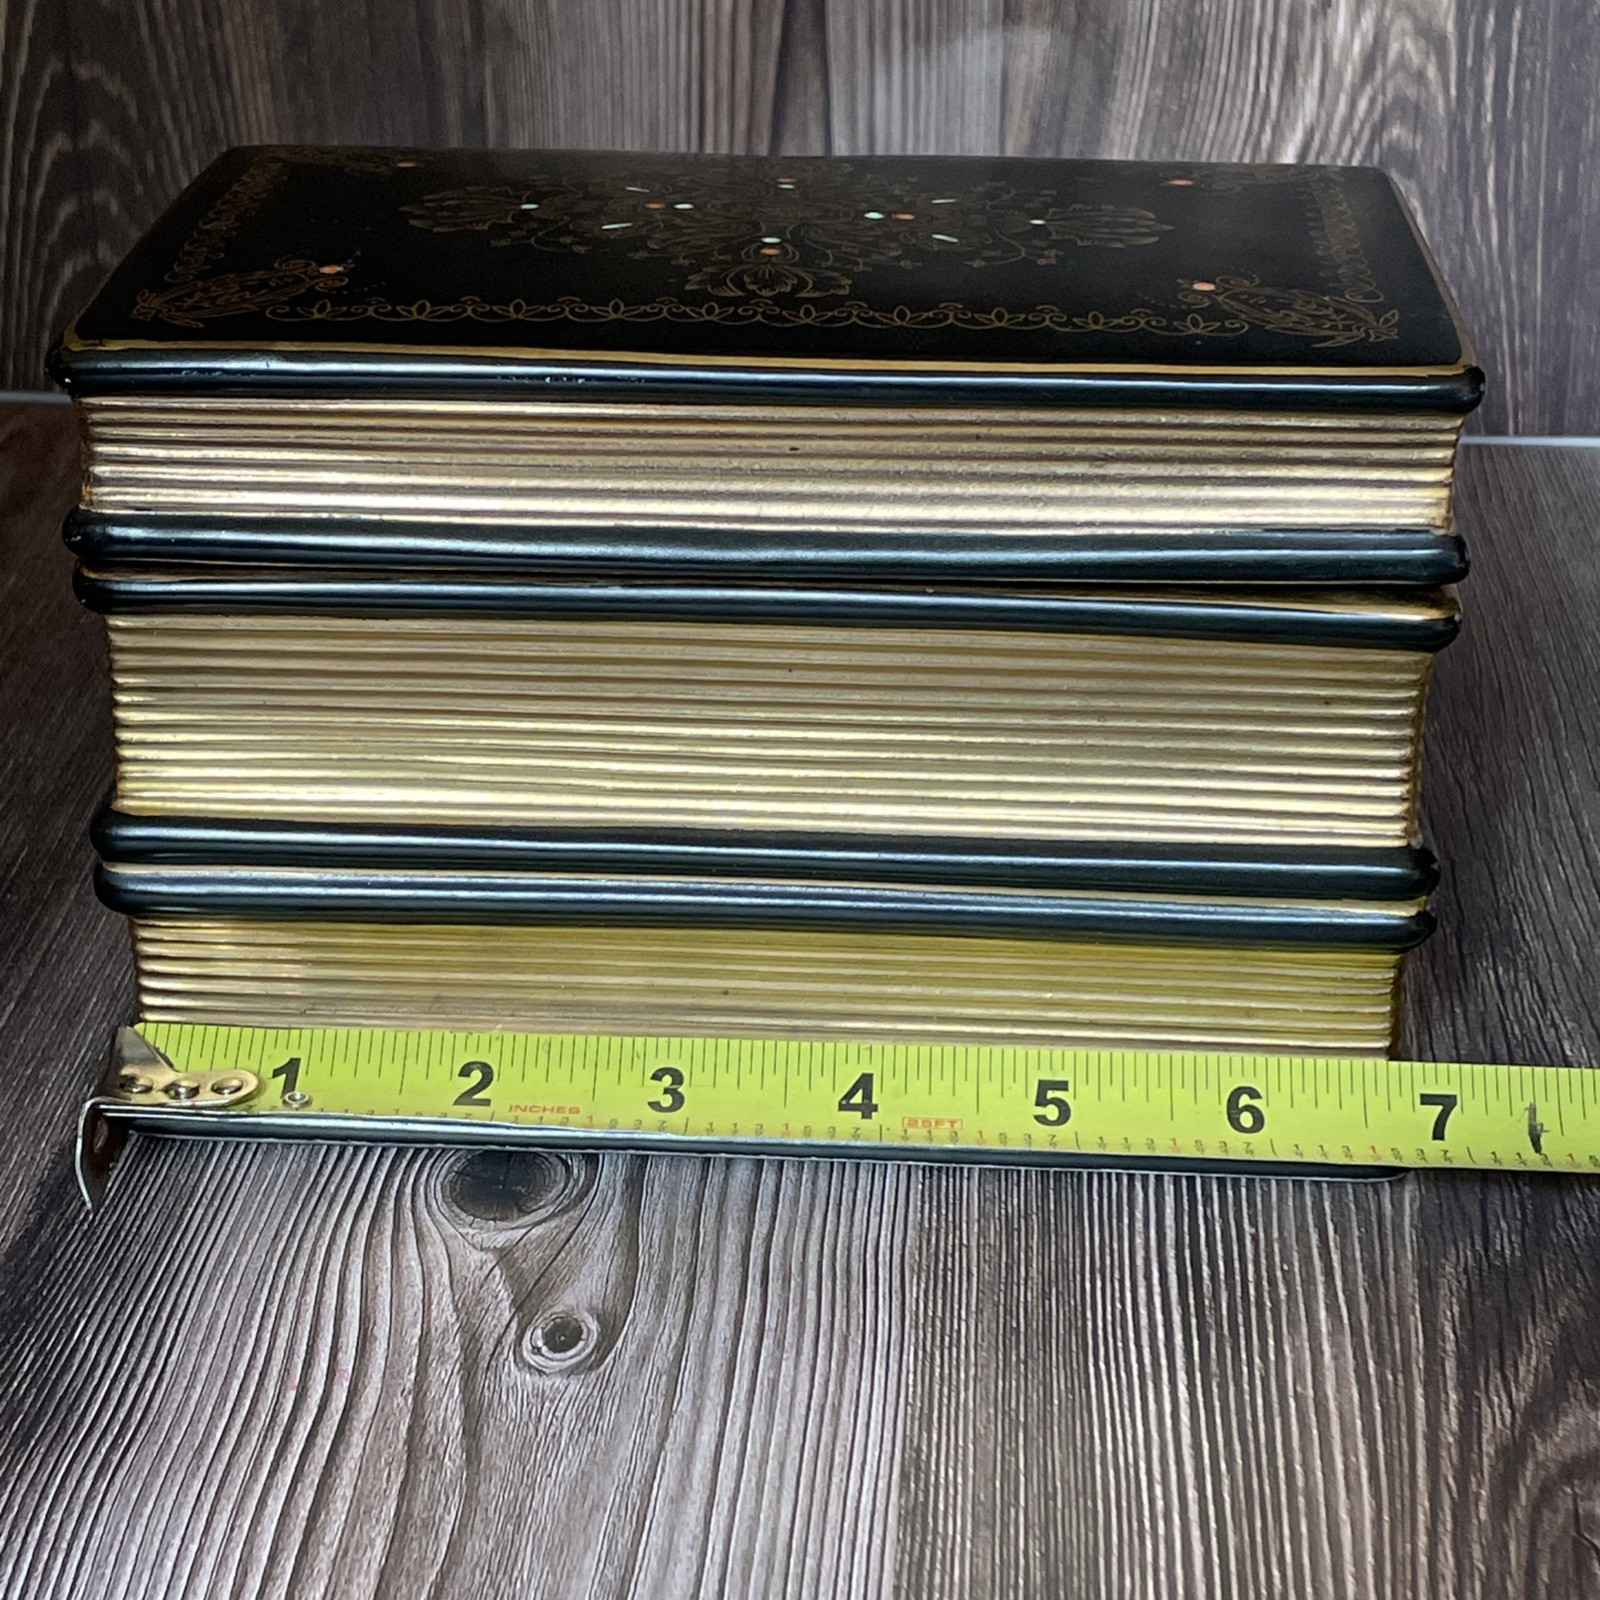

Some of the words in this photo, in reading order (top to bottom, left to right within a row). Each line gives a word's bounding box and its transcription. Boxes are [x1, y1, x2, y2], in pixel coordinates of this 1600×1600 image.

[271, 1057, 302, 1099] 1
[453, 1060, 494, 1107] 2
[647, 1066, 686, 1113] 3
[838, 1072, 879, 1120] 4
[1033, 1079, 1072, 1127] 5
[1226, 1085, 1265, 1134] 6
[1419, 1093, 1458, 1141] 7
[508, 1103, 581, 1115] INCHES
